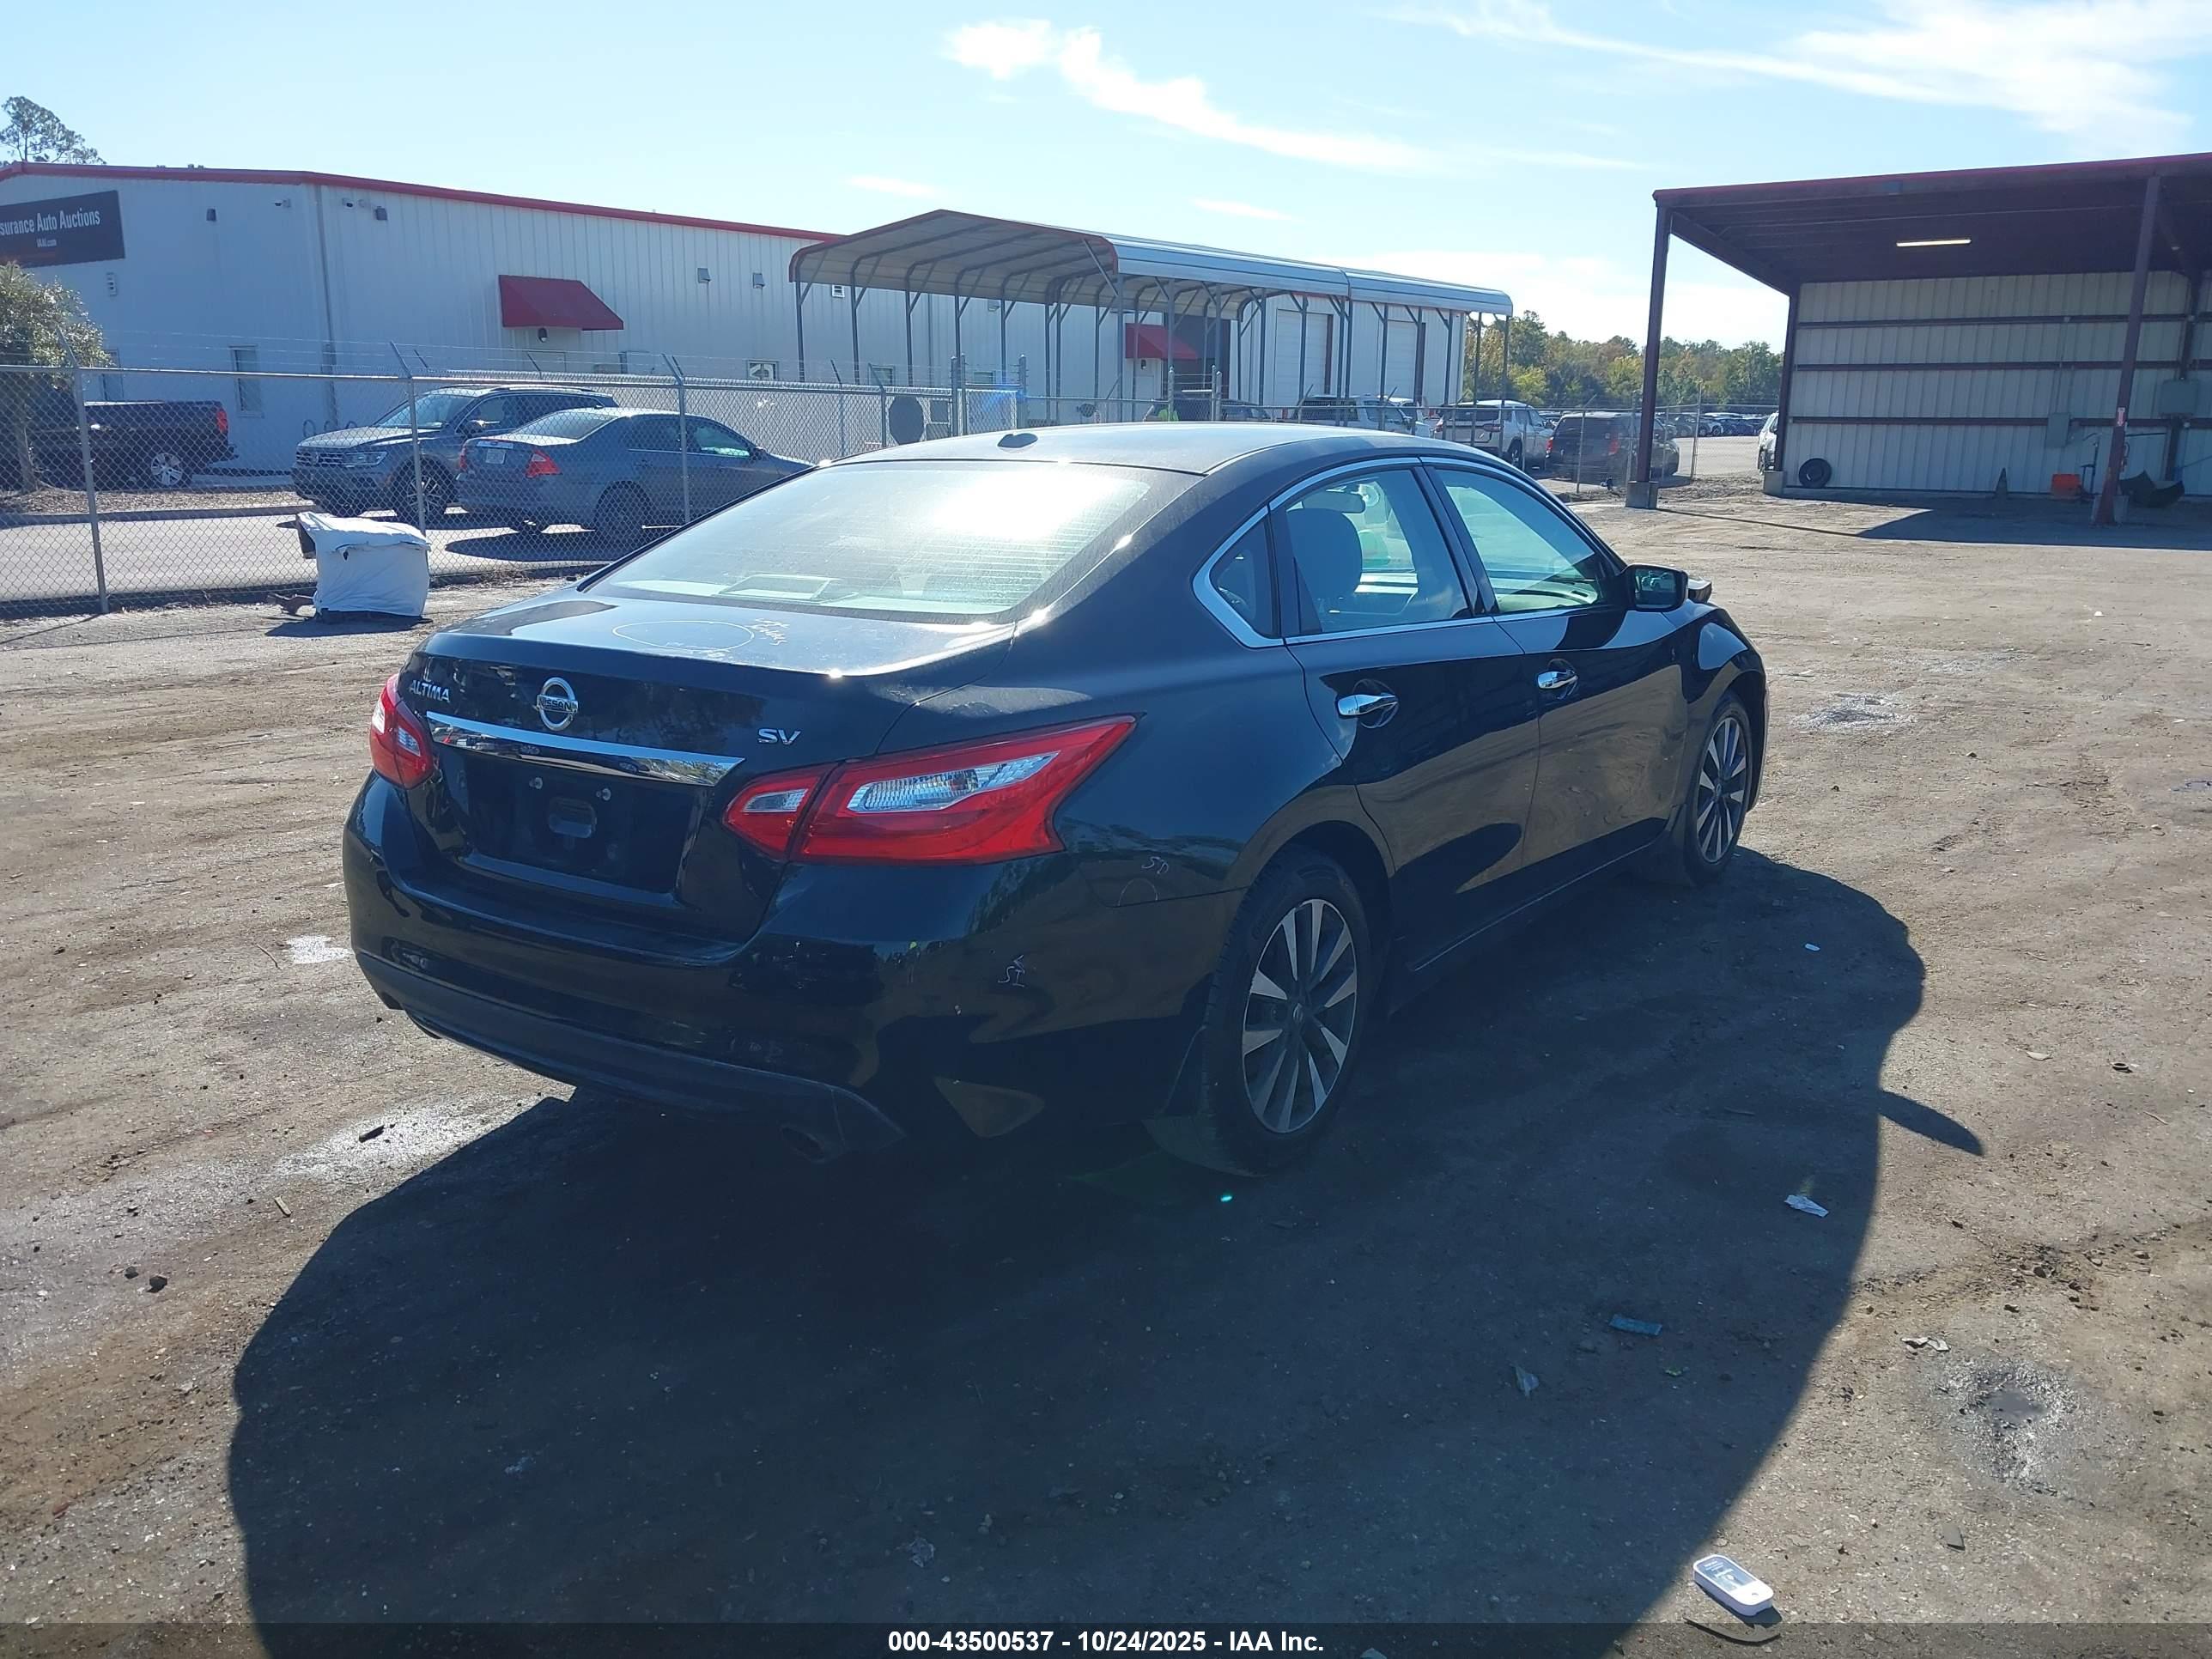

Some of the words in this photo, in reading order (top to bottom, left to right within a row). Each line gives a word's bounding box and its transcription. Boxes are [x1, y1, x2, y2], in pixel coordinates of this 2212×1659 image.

[37, 212, 58, 232] Auto
[59, 207, 100, 229] Auctions
[409, 679, 451, 703] ALTIMA
[539, 697, 572, 711] NISSAN
[758, 728, 801, 745] SV
